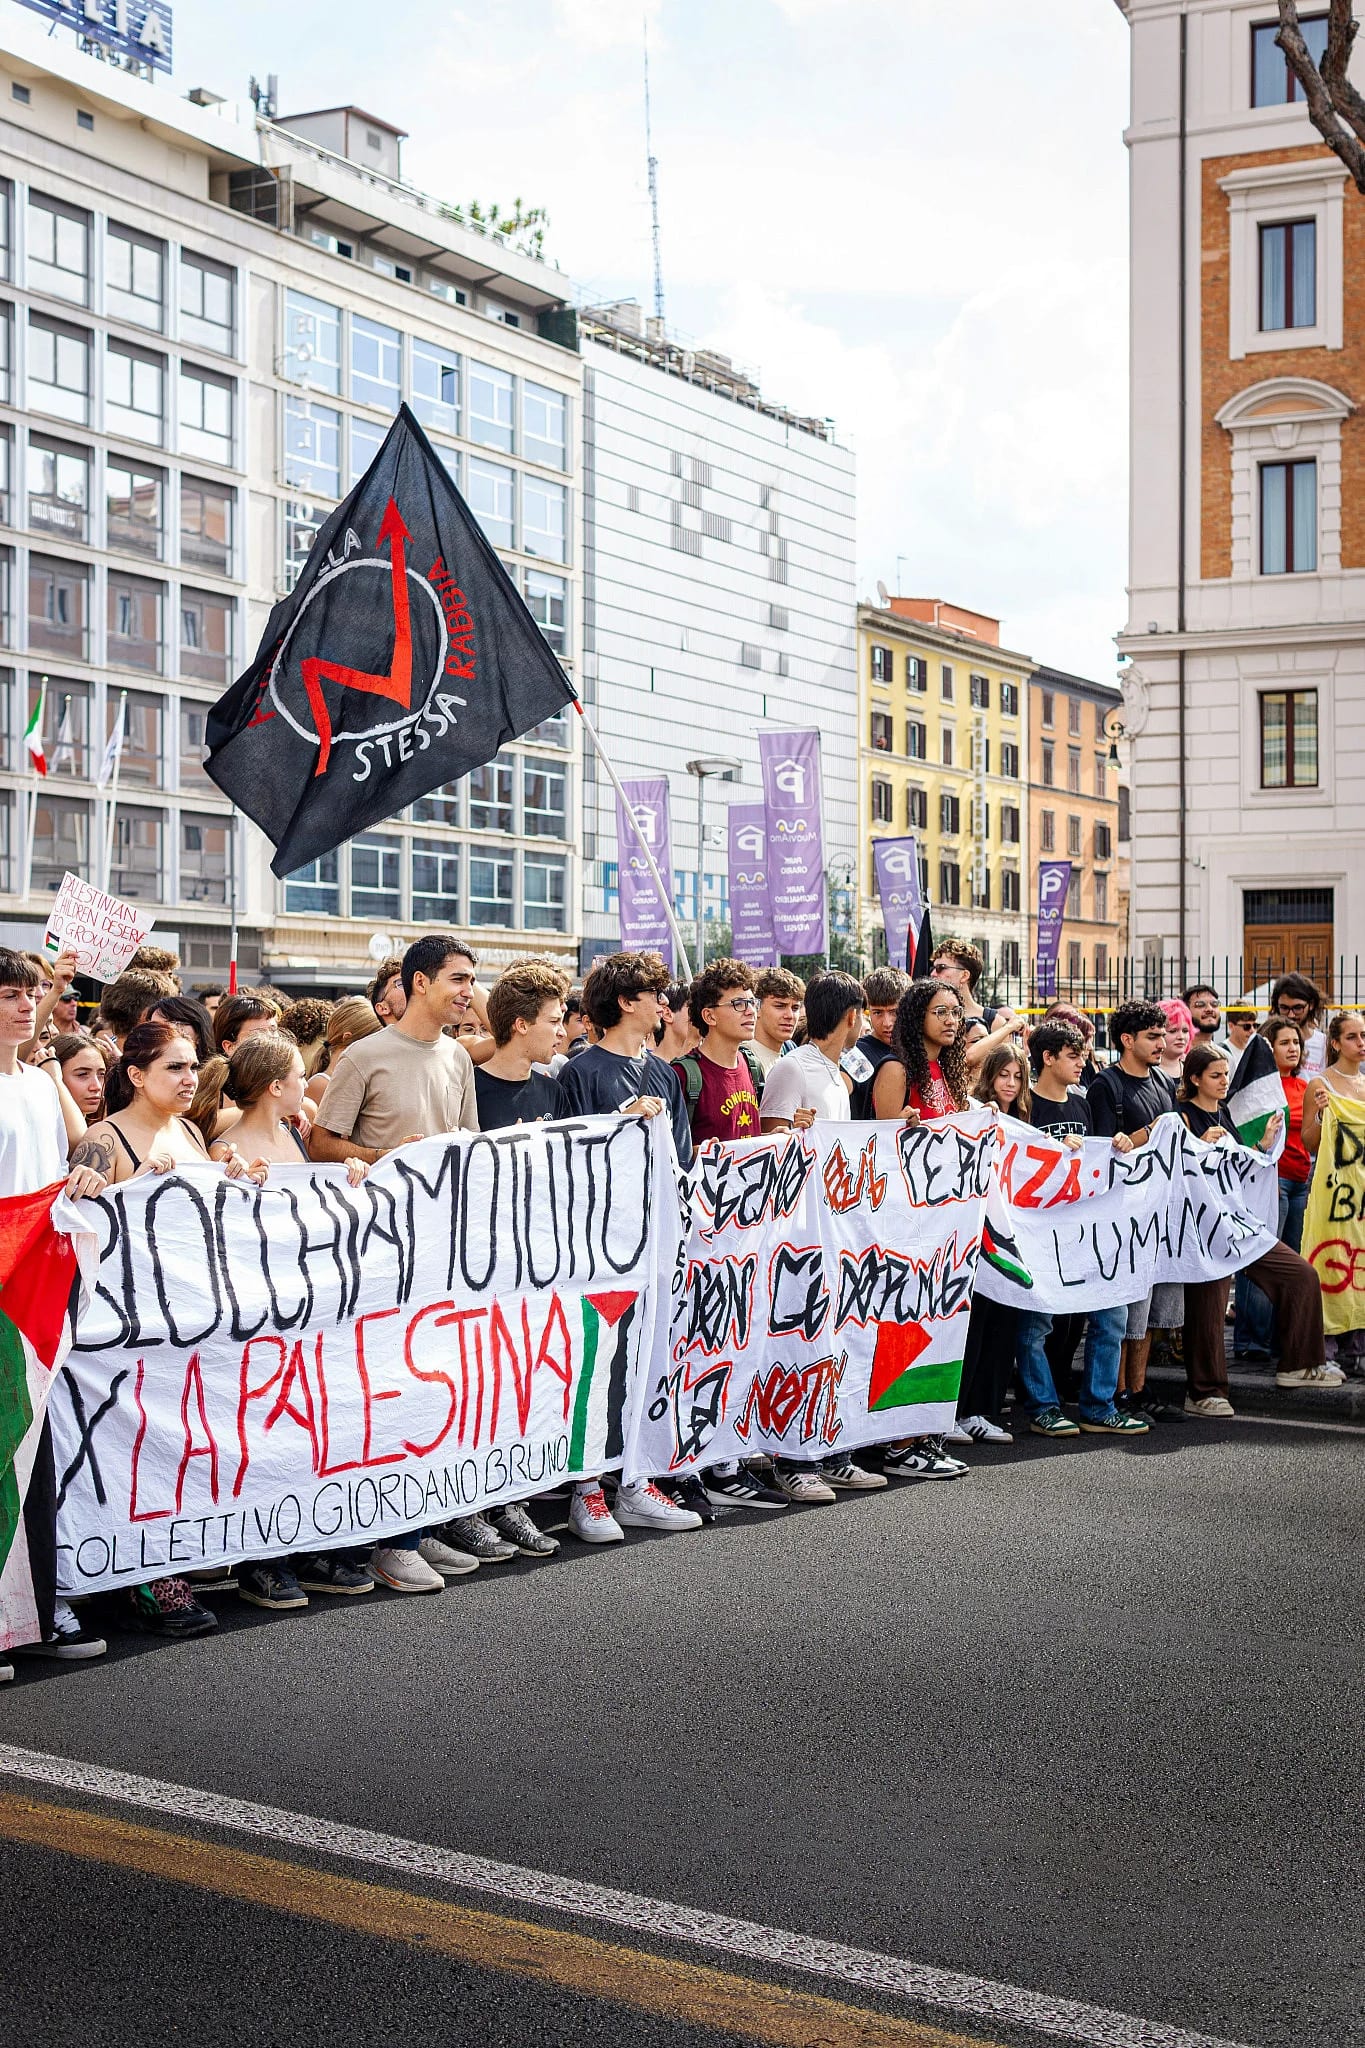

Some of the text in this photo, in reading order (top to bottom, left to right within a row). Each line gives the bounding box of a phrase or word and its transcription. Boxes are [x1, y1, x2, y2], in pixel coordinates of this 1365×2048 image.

[426, 556, 478, 680] RABBIA
[352, 693, 467, 782] STESSA
[53, 914, 134, 957] TO GROW UP
[62, 875, 138, 924] PALESTINIAN
[101, 916, 149, 945] DESERVE
[56, 1366, 130, 1511] X
[56, 1434, 569, 1578] OLLETTIVO GIORDANO BRUNO
